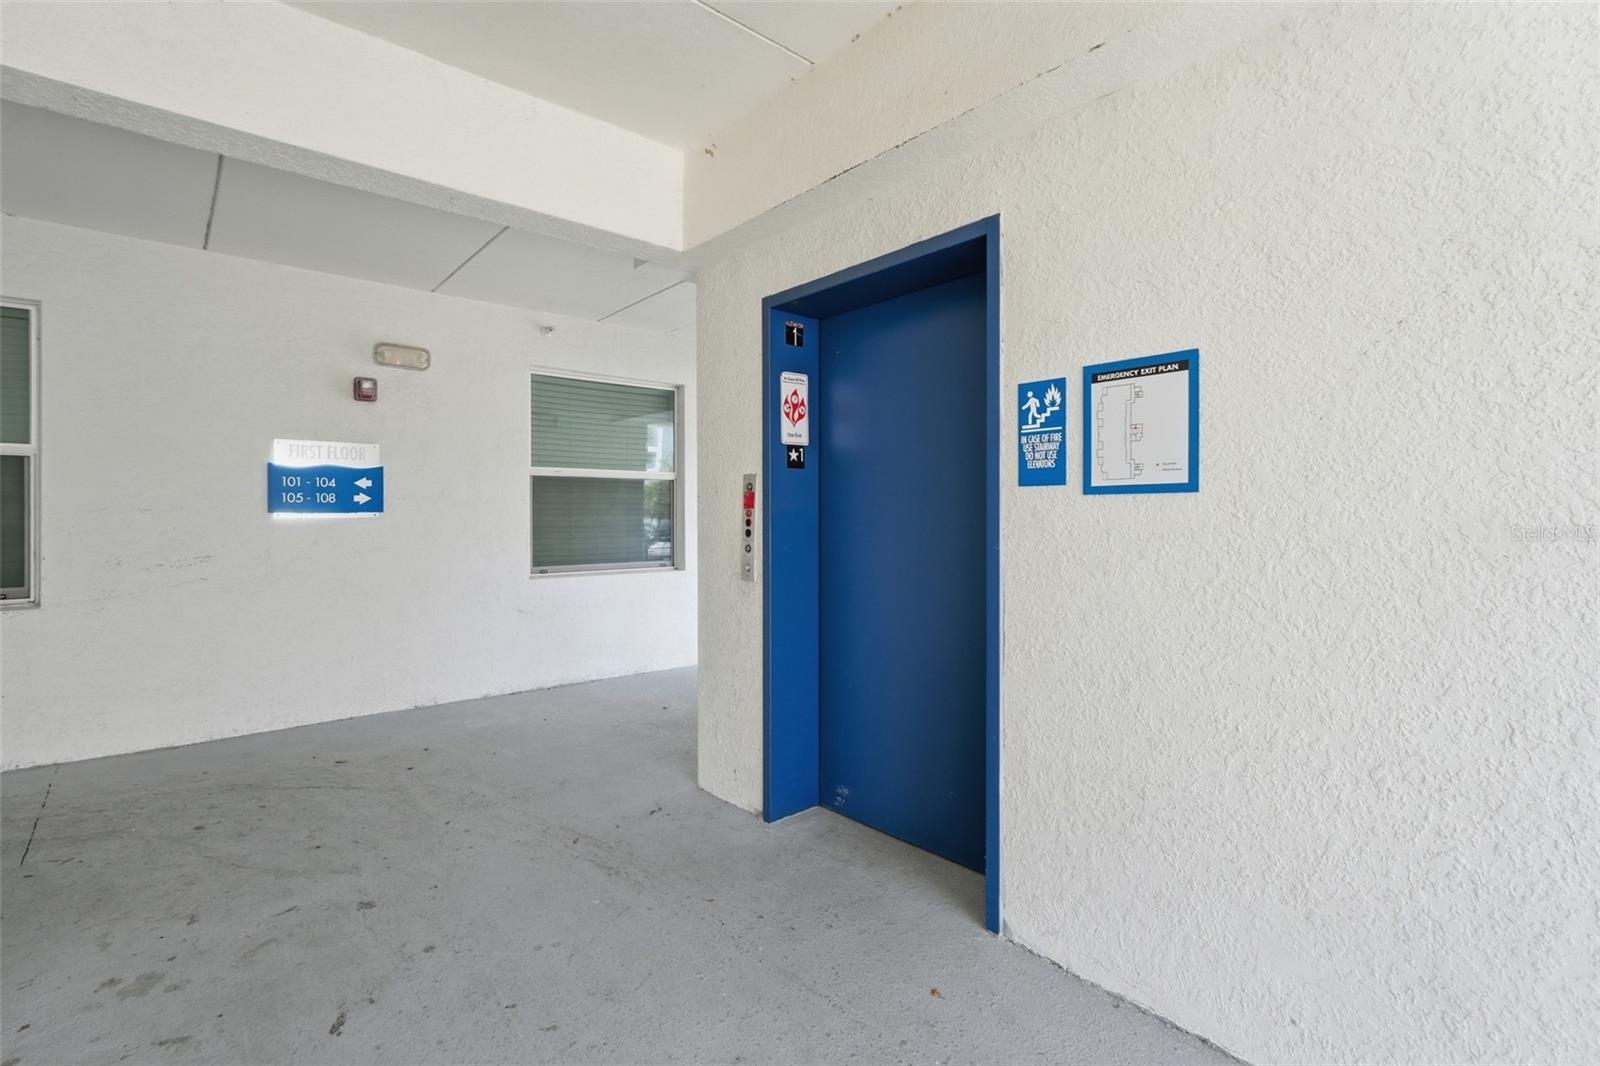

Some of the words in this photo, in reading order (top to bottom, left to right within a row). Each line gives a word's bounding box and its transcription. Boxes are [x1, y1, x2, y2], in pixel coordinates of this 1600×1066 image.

[792, 328, 797, 346] 1
[1097, 369, 1139, 381] EMERGENCY
[1140, 366, 1157, 375] EXIT
[1158, 363, 1179, 373] PLAN
[1020, 435, 1027, 444] IN
[1028, 434, 1041, 443] CASE
[1041, 433, 1049, 442] OF
[1050, 432, 1063, 441] FIRE
[289, 443, 323, 459] FIRST
[327, 445, 367, 461] FLOOR
[1023, 443, 1033, 452] USE
[1033, 442, 1060, 452] STAIRWAY
[1025, 451, 1034, 460] DO
[1034, 450, 1046, 460] NOT
[1046, 449, 1058, 459] USE
[1027, 458, 1056, 469] ELEVATORS
[281, 476, 301, 487] 101
[315, 476, 336, 488] 104
[281, 492, 304, 503] 105
[315, 492, 336, 503] 108
